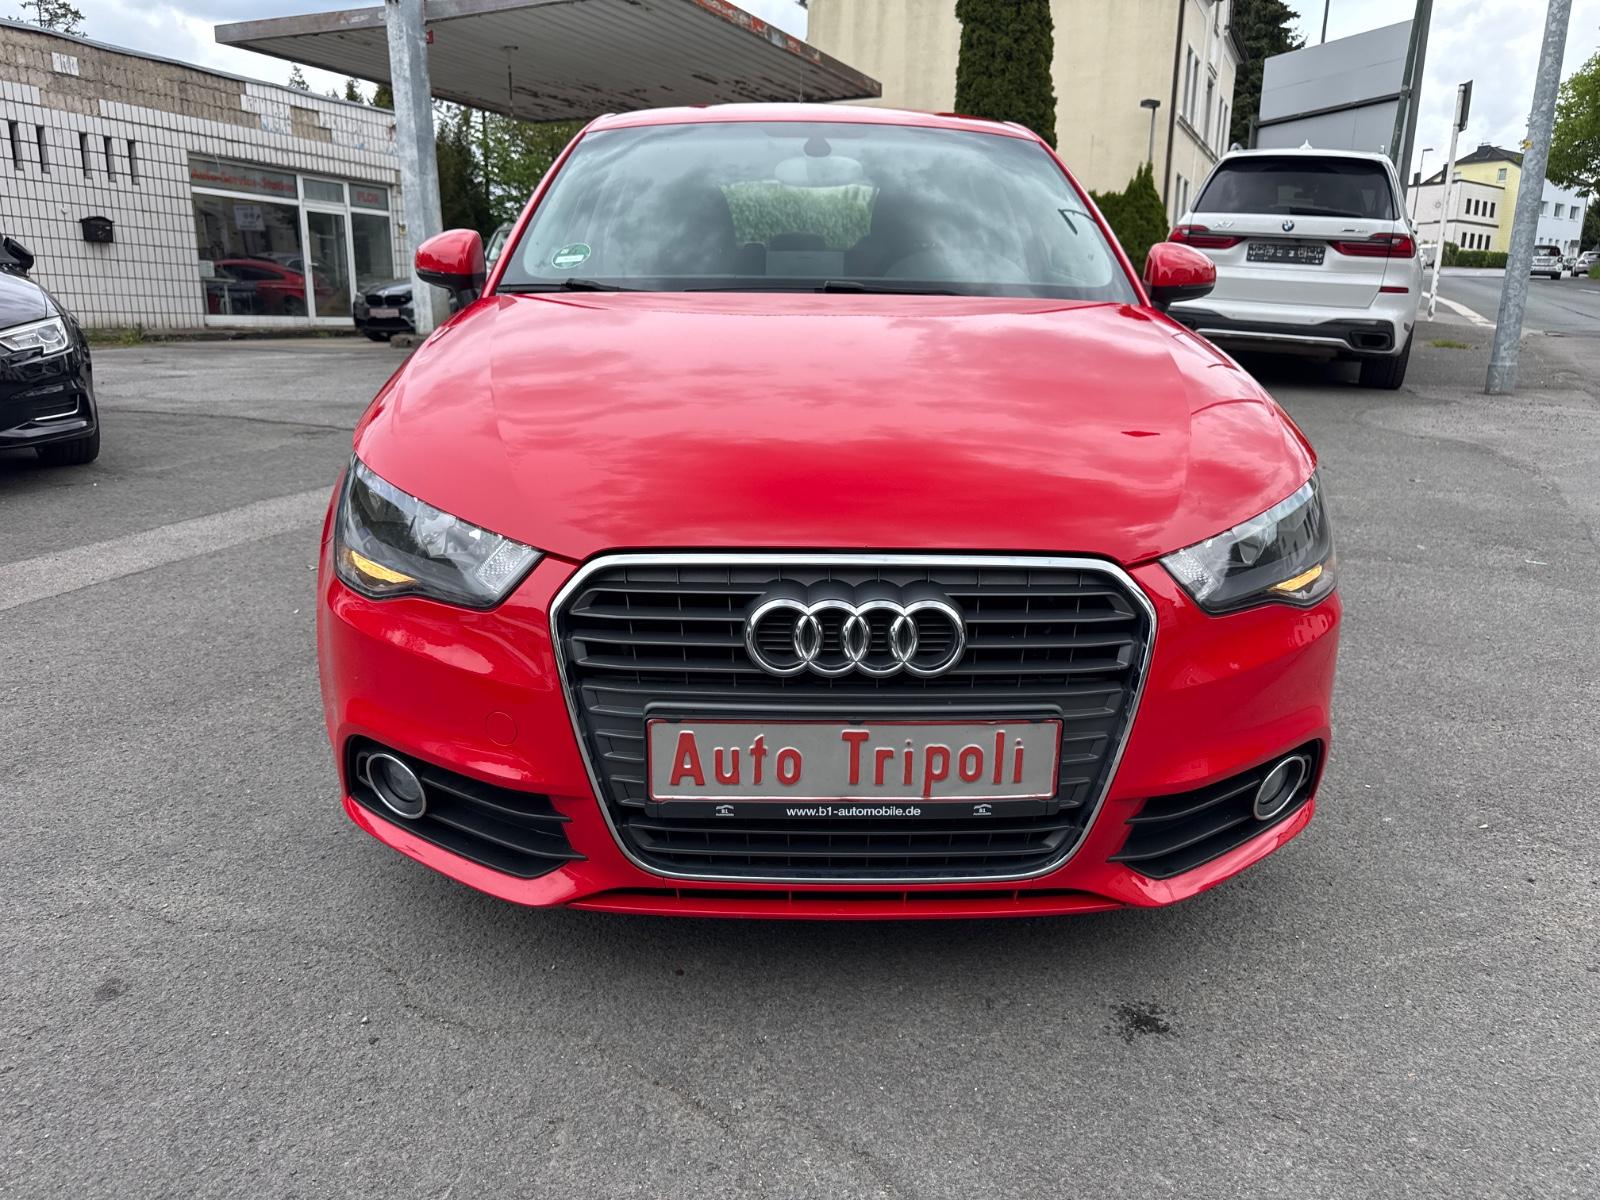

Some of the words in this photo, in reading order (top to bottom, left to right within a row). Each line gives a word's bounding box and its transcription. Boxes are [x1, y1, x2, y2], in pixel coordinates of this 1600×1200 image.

[669, 730, 803, 786] Auto
[841, 729, 1025, 798] Tripoli
[786, 805, 921, 816] www.b1-automobile.de
